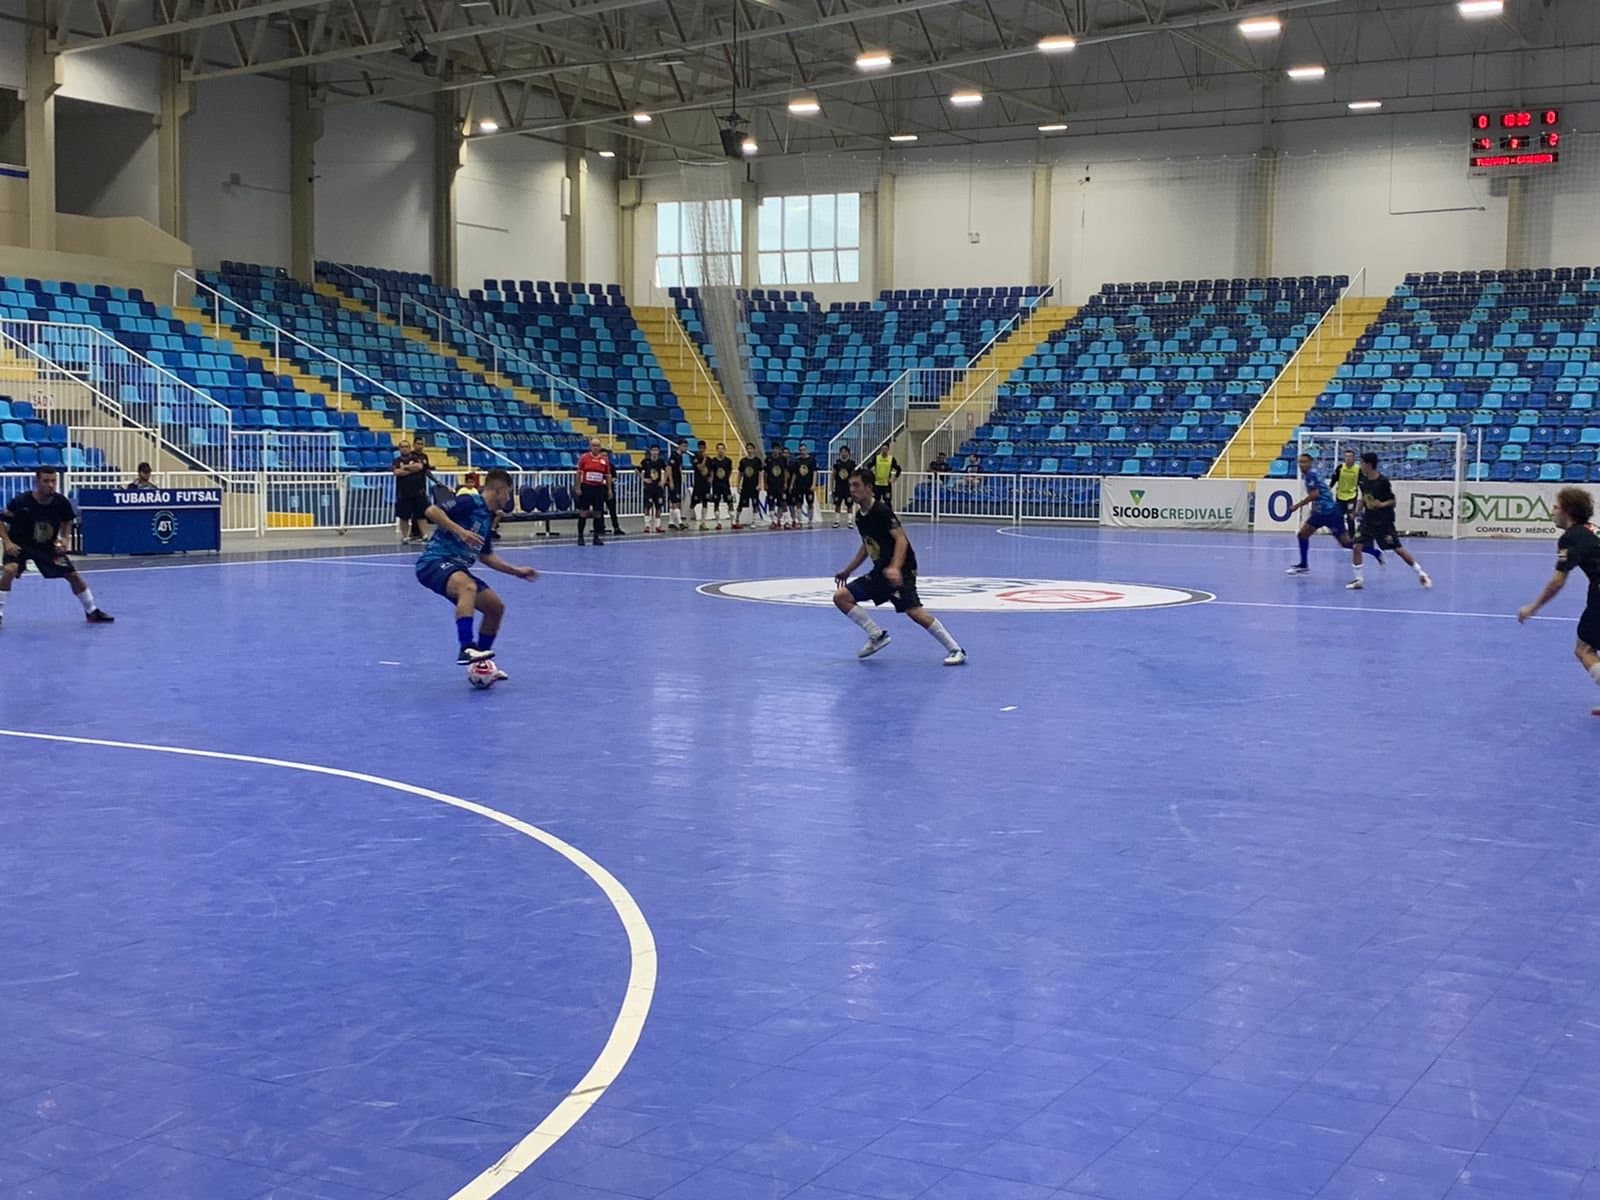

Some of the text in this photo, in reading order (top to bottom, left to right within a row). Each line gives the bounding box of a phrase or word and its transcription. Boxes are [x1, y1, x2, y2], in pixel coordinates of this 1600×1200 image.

[1478, 115, 1488, 129] 0
[1546, 111, 1556, 124] 0
[113, 490, 219, 504] TUBARÃO FUTSAL
[1475, 526, 1522, 534] COMPLEXO
